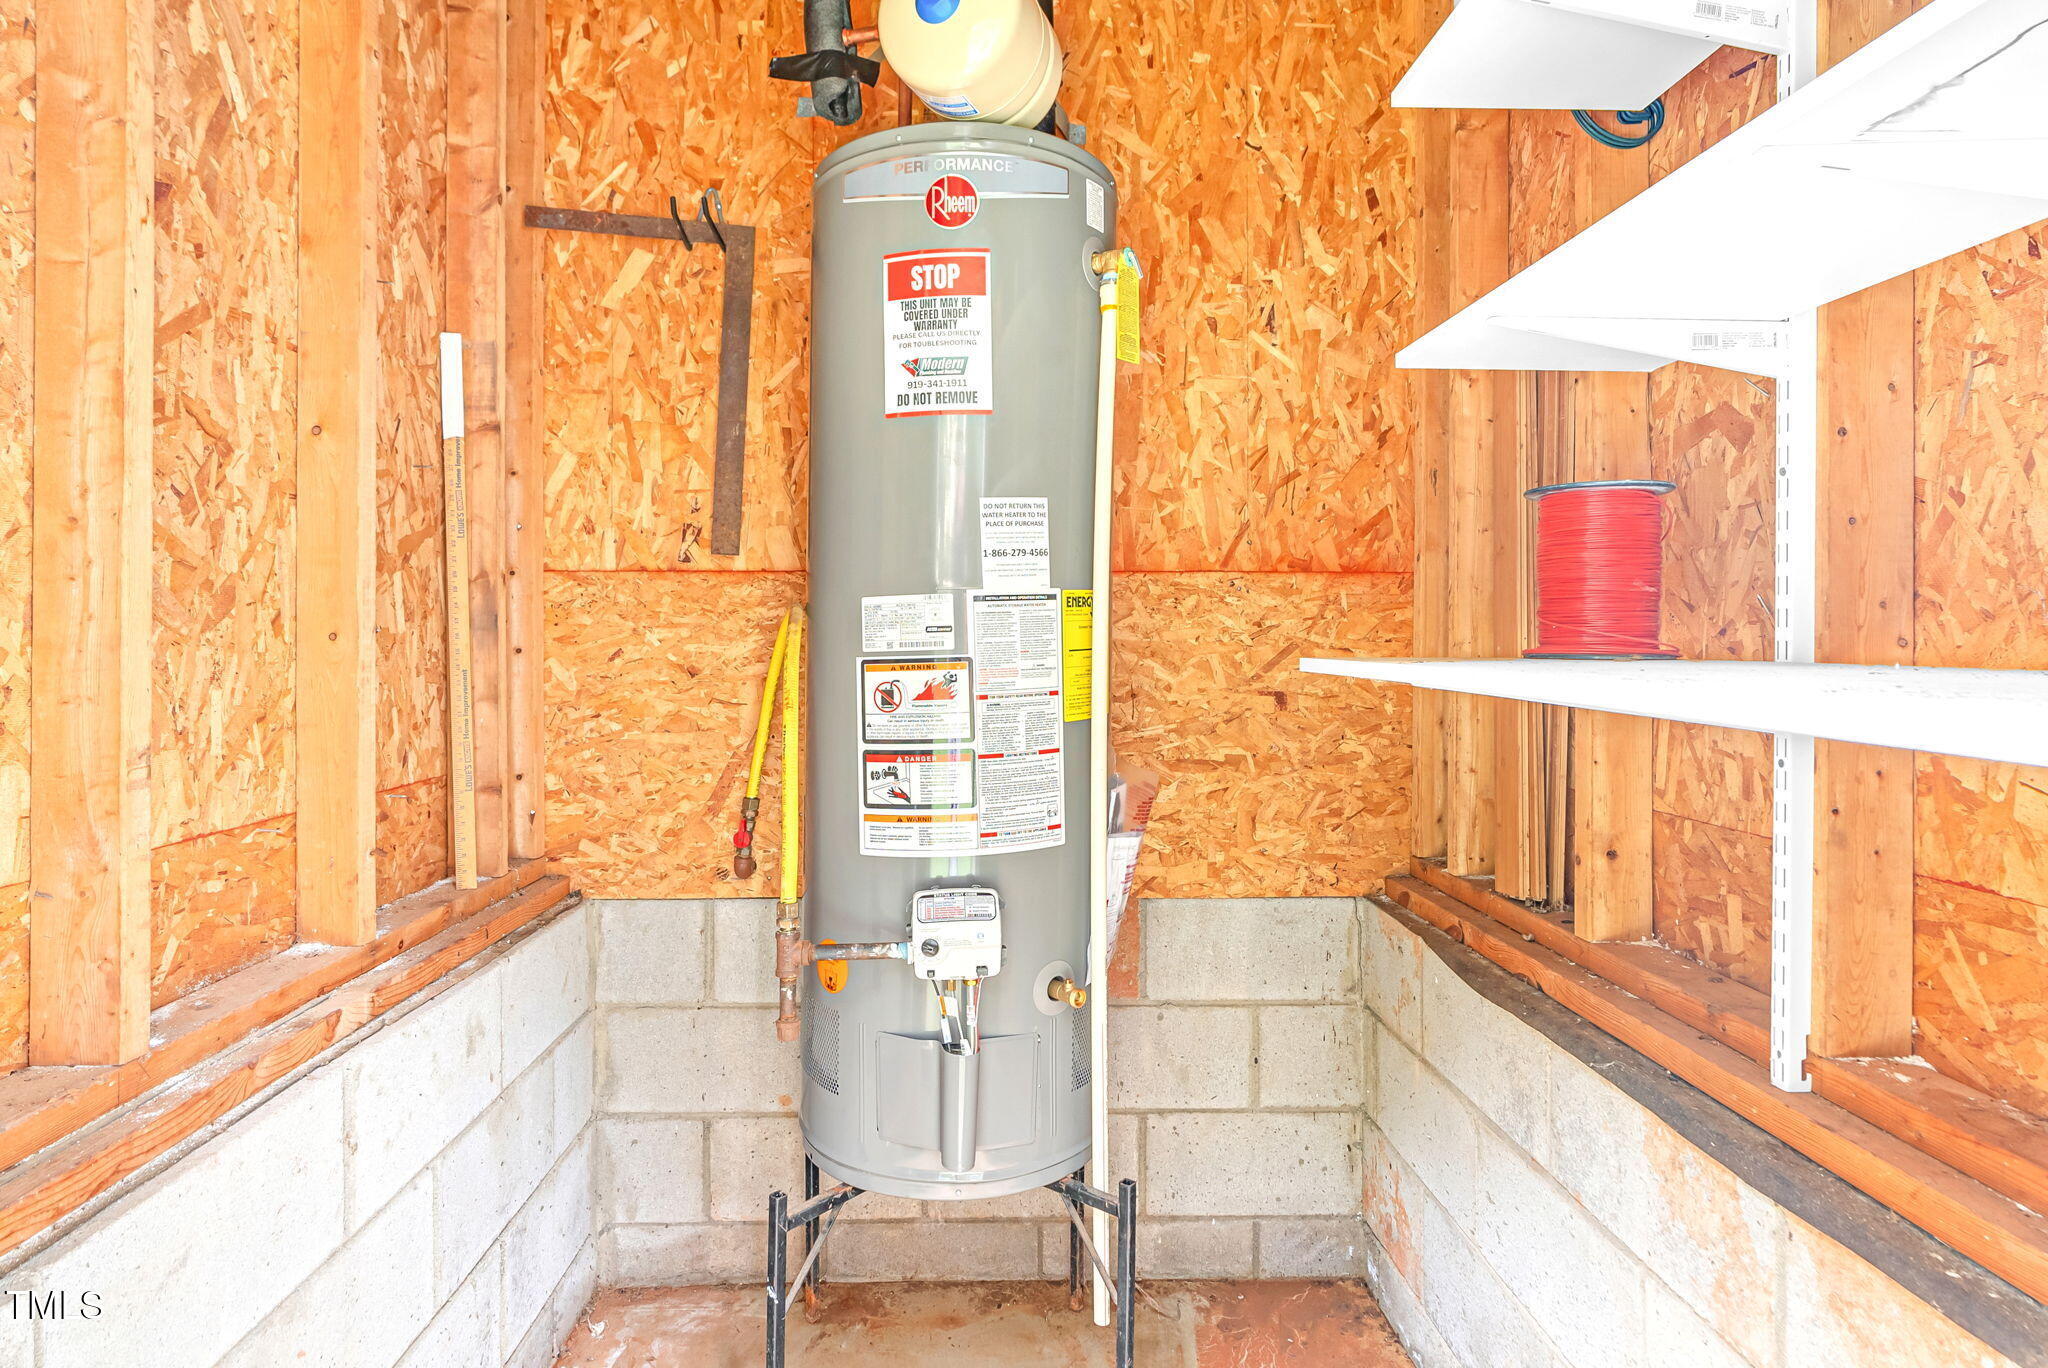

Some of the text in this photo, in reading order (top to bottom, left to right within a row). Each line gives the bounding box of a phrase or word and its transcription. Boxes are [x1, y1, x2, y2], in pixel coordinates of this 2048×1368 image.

[932, 176, 976, 220] Rheem
[911, 263, 960, 291] STOP
[901, 297, 972, 311] THIS UNIT MAY BE
[904, 308, 968, 321] COVERED UNDER
[914, 320, 958, 331] WARRANTY
[914, 339, 977, 348] TOUBLESHOOTING
[922, 358, 964, 371] Modern
[907, 379, 967, 389] 919-341-1911
[897, 391, 978, 406] DO NOT REMOVE
[983, 549, 1048, 558] 1-866-279-4566
